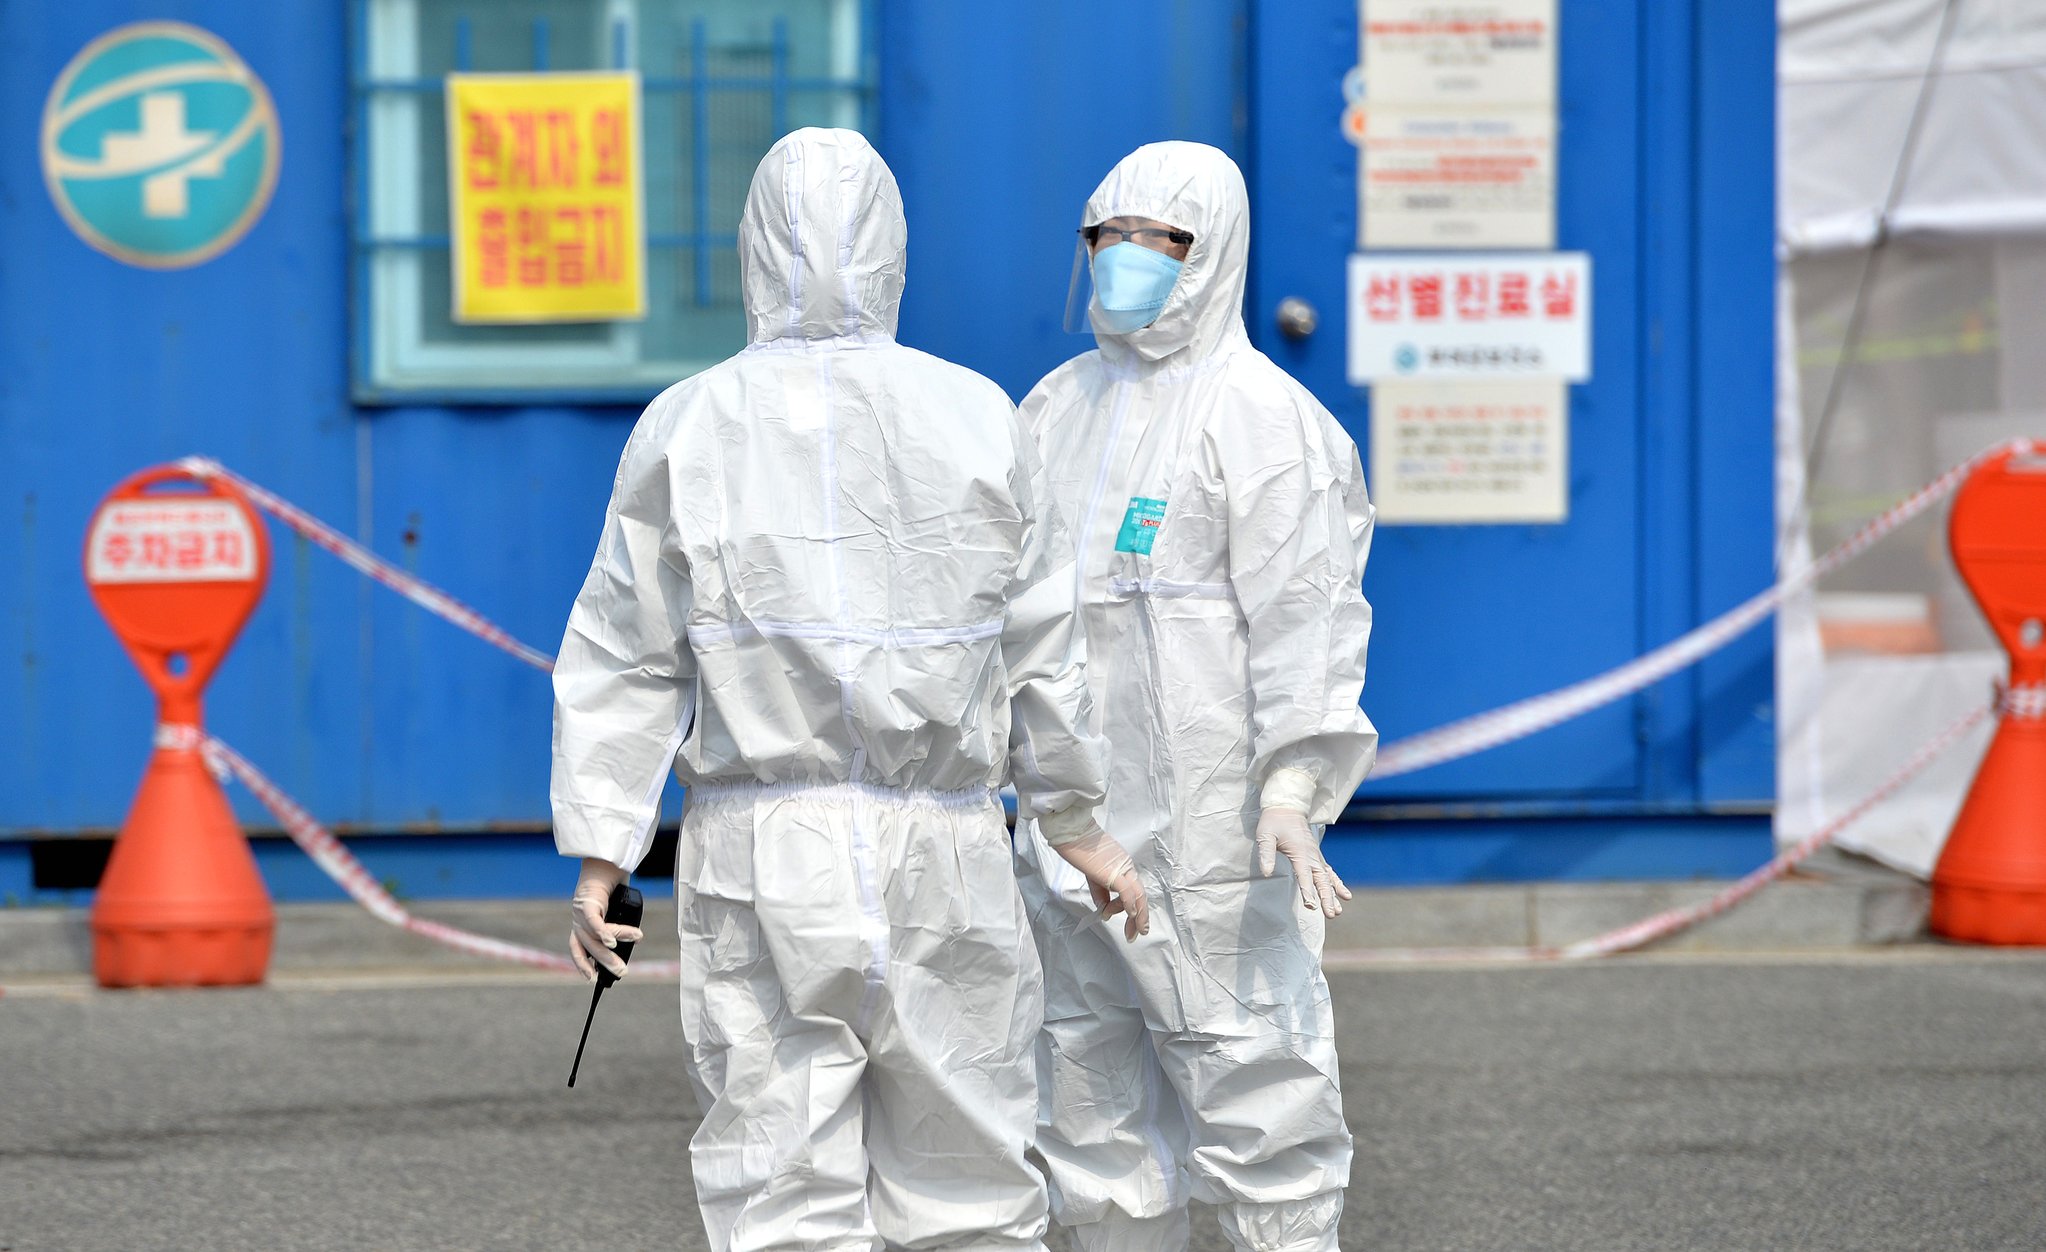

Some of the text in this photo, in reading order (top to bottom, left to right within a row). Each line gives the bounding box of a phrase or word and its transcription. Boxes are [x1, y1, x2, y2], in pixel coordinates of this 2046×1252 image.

[469, 110, 624, 189] 관계자 외
[480, 207, 624, 288] 출입금지
[1365, 271, 1577, 322] 선별진료실
[104, 531, 242, 569] 주차금지
